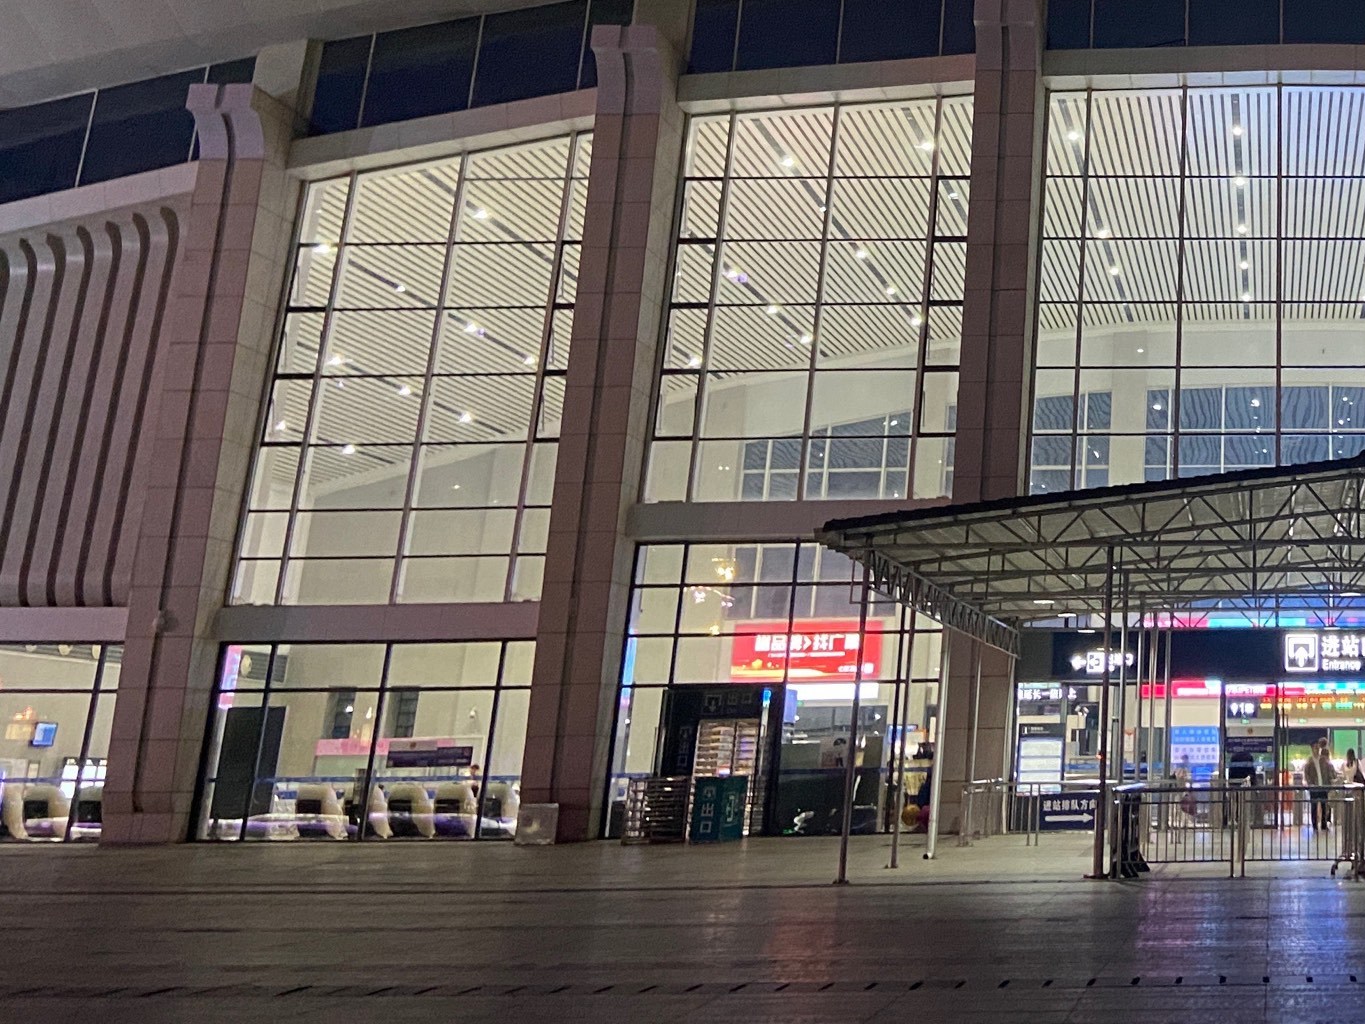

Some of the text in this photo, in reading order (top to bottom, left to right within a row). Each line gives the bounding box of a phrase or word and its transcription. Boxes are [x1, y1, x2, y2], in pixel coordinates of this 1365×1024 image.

[1322, 659, 1361, 671] Entrance
[1043, 799, 1097, 812] 进站排队方向
[699, 803, 714, 833] 出口
